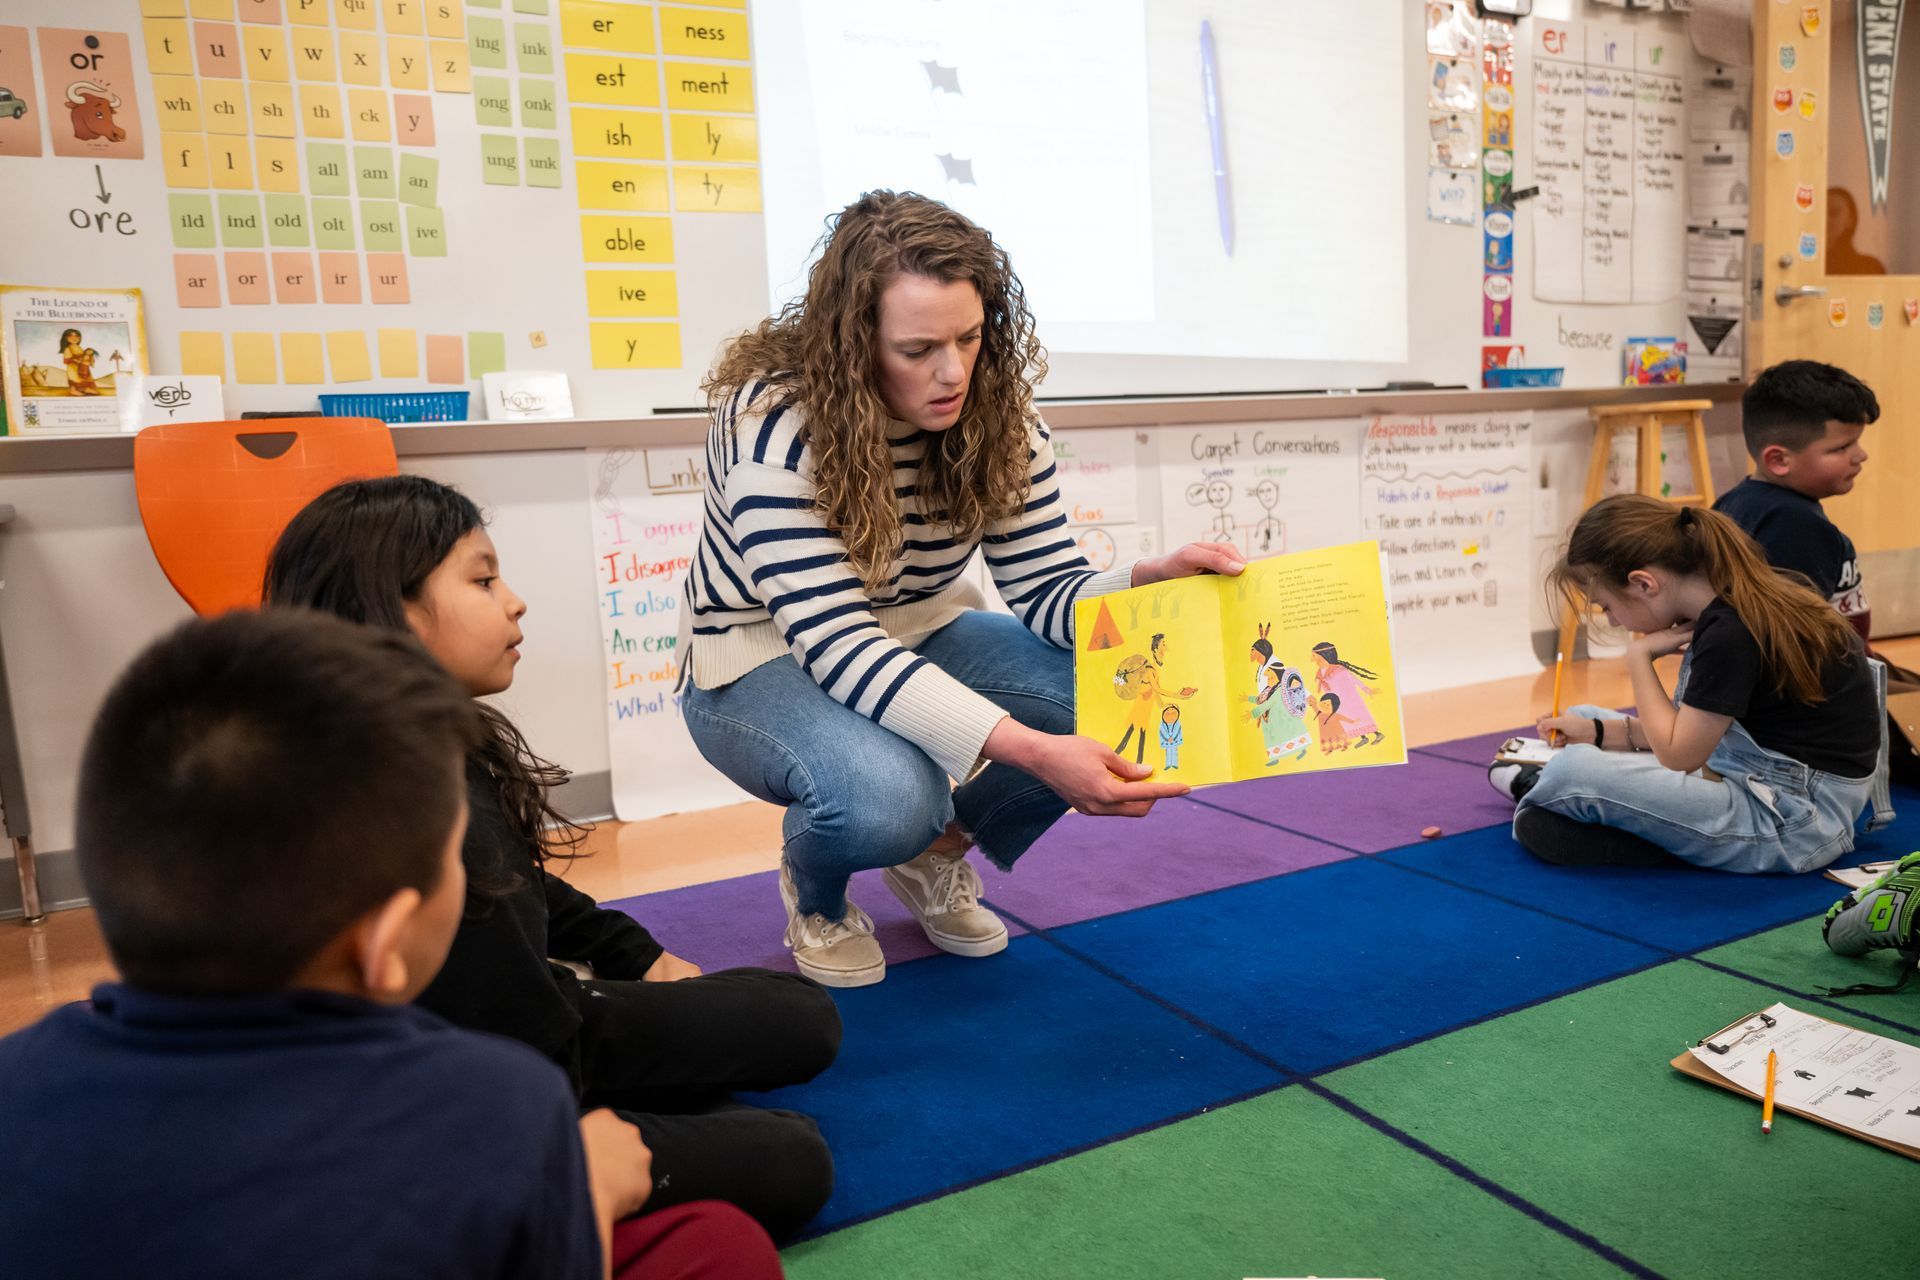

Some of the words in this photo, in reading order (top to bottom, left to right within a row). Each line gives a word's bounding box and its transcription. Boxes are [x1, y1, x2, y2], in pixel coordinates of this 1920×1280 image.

[397, 2, 406, 14] r
[439, 7, 450, 18] s
[593, 19, 614, 32] er
[685, 26, 725, 41] ness
[1542, 29, 1566, 54] er
[162, 37, 172, 54] t
[210, 42, 225, 57] u
[259, 48, 272, 61] v
[304, 48, 324, 60] w
[354, 53, 367, 66] x
[401, 58, 413, 74] y
[445, 61, 457, 73] z
[476, 37, 500, 53] ing
[522, 42, 547, 55] ink
[70, 53, 104, 70] or
[596, 63, 626, 87] est
[682, 72, 728, 94] ment
[164, 97, 191, 112] wh
[214, 100, 235, 115] ch
[262, 103, 283, 117] sh
[312, 105, 331, 118] th
[360, 109, 379, 122] ck
[409, 115, 420, 131] y
[480, 96, 509, 112] ong
[524, 98, 552, 111] onk
[1867, 64, 1891, 141] STATE
[607, 123, 631, 146] ish
[707, 121, 720, 155] ly
[181, 150, 190, 167] f
[271, 160, 284, 173] s
[318, 164, 339, 176] all
[363, 168, 388, 180] am
[408, 176, 429, 188] an
[487, 155, 516, 171] ung
[529, 157, 557, 170] unk
[612, 179, 635, 193] en
[703, 172, 723, 206] ty
[69, 207, 137, 236] ore
[182, 214, 205, 228] ild
[227, 215, 256, 228] ind
[274, 214, 302, 228] old
[323, 219, 344, 231] olt
[369, 221, 394, 233] ost
[416, 226, 438, 238] ive
[605, 228, 646, 251] able
[188, 276, 206, 288] ar
[238, 273, 257, 285] or
[286, 273, 303, 285] er
[334, 273, 347, 284] ir
[380, 274, 397, 285] ur
[619, 285, 646, 301] ive
[1558, 314, 1613, 350] because
[626, 338, 637, 361] y
[148, 381, 192, 402] verb
[1369, 416, 1438, 440] Responsible
[1445, 422, 1476, 433] means
[1484, 418, 1511, 437] doing
[1190, 432, 1240, 464] Carpet
[1253, 431, 1340, 456] Conversations
[1385, 442, 1422, 455] whether
[1425, 445, 1436, 454] or
[1438, 442, 1454, 452] not
[1470, 438, 1501, 450] teacher
[1377, 487, 1408, 504] Habits
[1411, 488, 1422, 502] of
[1073, 503, 1104, 522] Gas
[1377, 514, 1400, 529] Take
[1404, 517, 1422, 528] care
[1427, 511, 1437, 526] of
[1440, 510, 1482, 525] materials
[606, 512, 631, 544] I
[644, 521, 696, 543] agree
[1411, 538, 1456, 553] directions
[603, 551, 622, 584] I
[1390, 570, 1411, 586] sten
[1414, 568, 1431, 582] and
[1436, 566, 1466, 579] Learn
[606, 590, 624, 617] I
[635, 590, 676, 616] also
[1392, 593, 1424, 615] mplete
[1430, 595, 1450, 611] your
[1455, 590, 1479, 605] work
[613, 628, 637, 655] An
[612, 661, 643, 689] In
[616, 692, 664, 720] What
